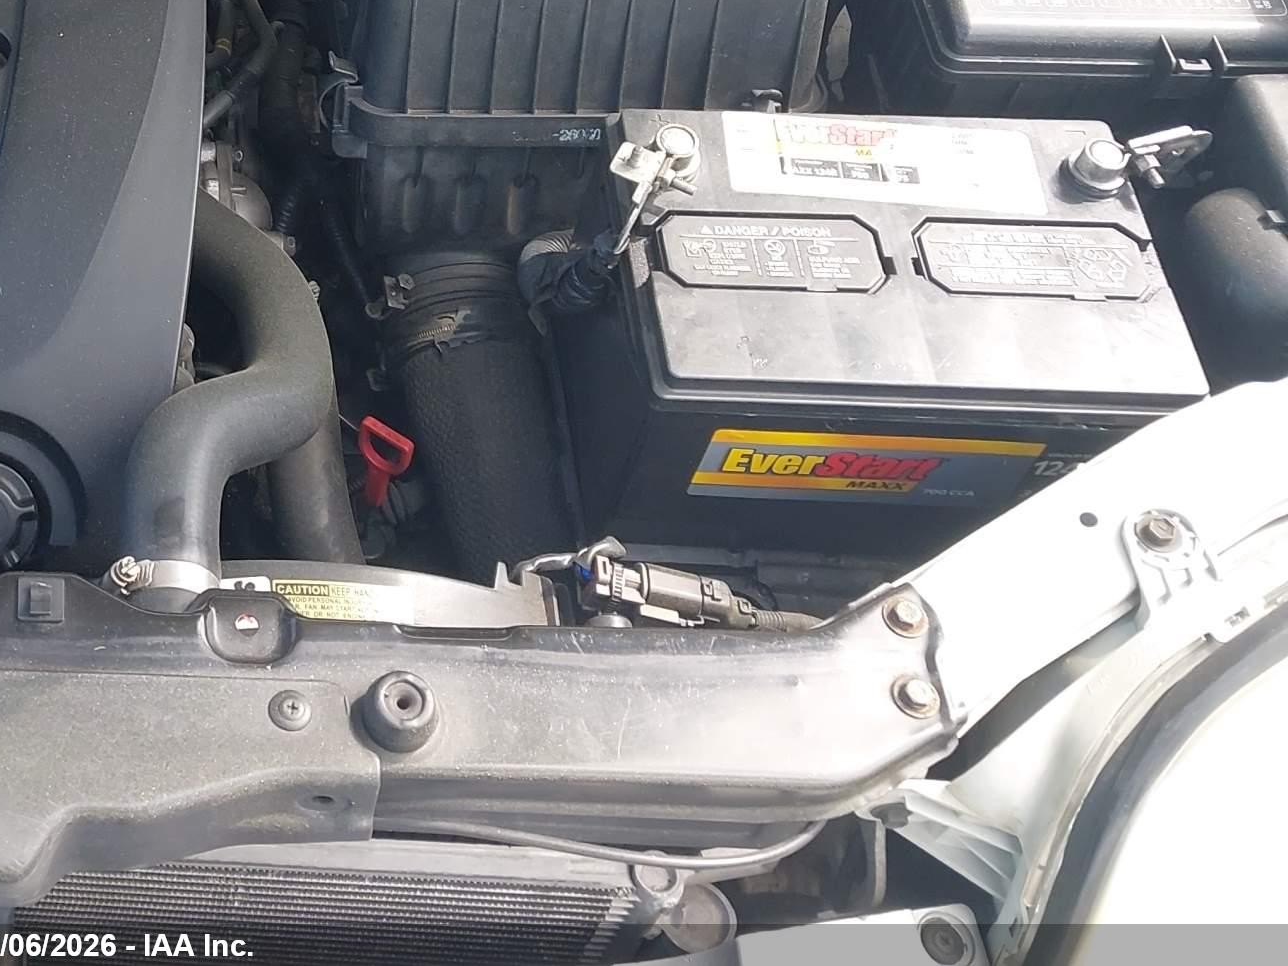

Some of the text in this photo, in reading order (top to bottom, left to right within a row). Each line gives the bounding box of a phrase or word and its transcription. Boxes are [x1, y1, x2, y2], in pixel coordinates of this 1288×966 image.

[713, 225, 769, 236] DANGER
[781, 226, 832, 237] POISON
[722, 446, 943, 481] EverStart
[845, 480, 908, 491] MAXX
[276, 584, 329, 596] CAUTION
[331, 586, 351, 596] KEEP
[308, 597, 342, 605] PERSONAL
